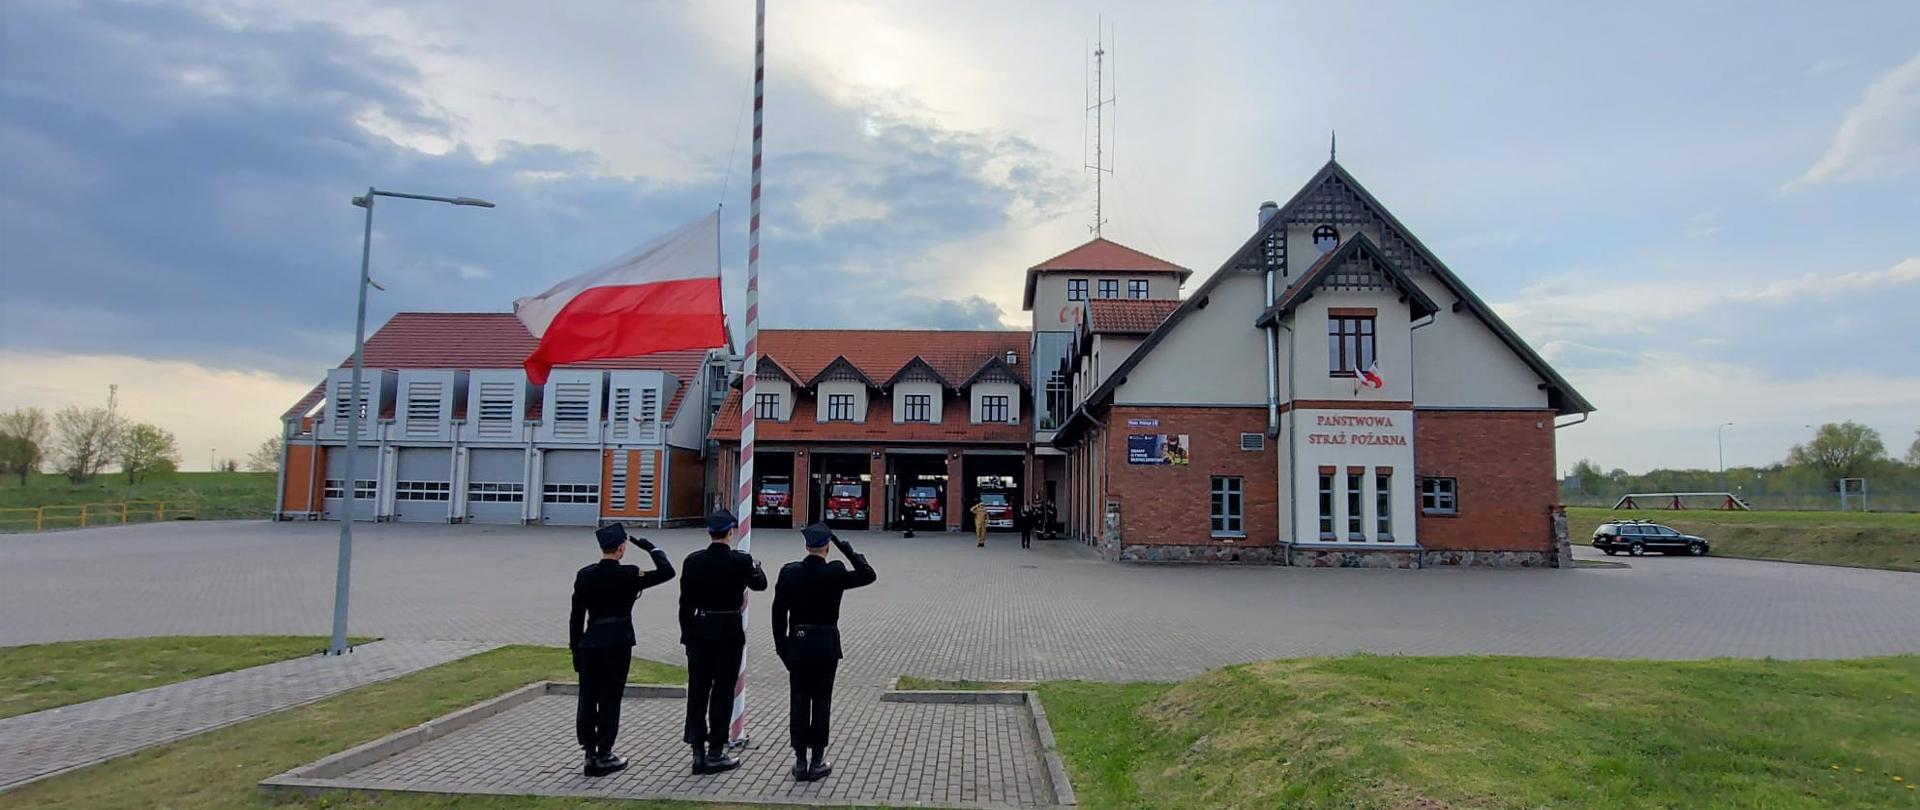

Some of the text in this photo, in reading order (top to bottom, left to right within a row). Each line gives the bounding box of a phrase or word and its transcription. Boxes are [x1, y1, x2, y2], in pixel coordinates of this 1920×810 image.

[1316, 413, 1394, 427] PAŃSTWOWA
[1308, 431, 1408, 446] STRAŻ POŻARNA
